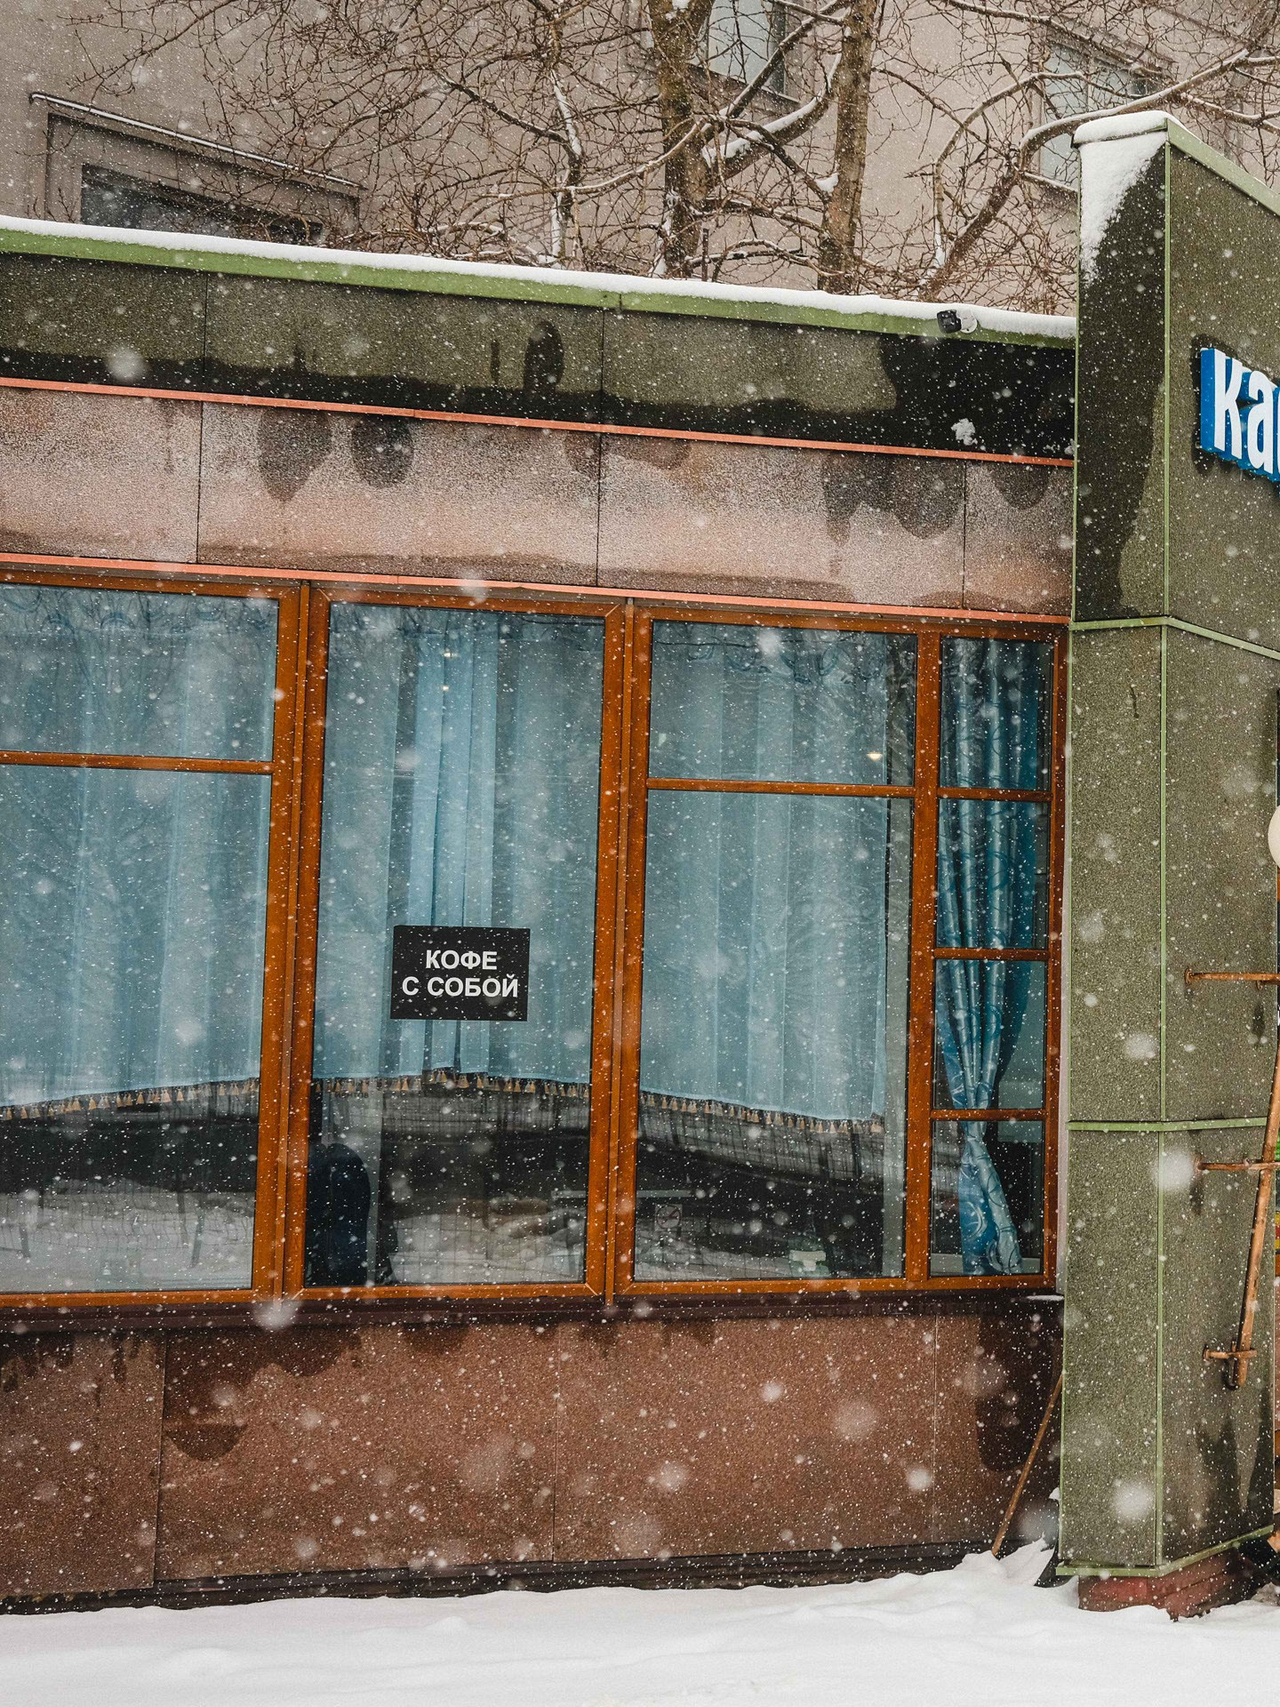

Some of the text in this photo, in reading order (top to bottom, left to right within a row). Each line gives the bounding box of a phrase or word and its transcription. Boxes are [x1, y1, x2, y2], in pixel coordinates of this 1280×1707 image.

[425, 949, 499, 970] КОФЕ
[401, 973, 520, 998] С СОБОЙ
